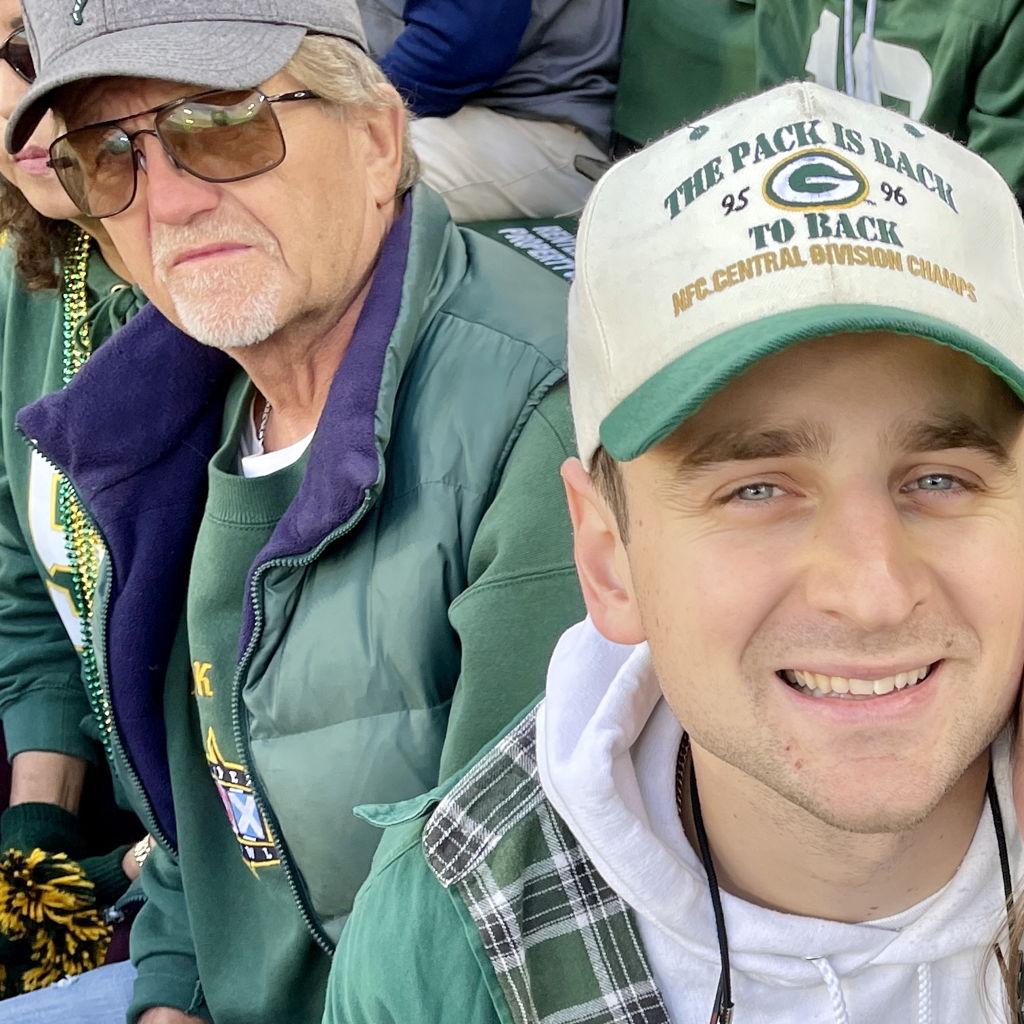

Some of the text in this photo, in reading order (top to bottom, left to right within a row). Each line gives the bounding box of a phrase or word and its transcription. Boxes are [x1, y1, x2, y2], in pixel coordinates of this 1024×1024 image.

[664, 119, 959, 220] THE PACK IS BACK
[721, 186, 750, 216] 95
[880, 181, 907, 206] 96
[748, 212, 904, 250] TO BACK
[672, 243, 977, 318] NFC CENTRAL DIVISION CHAMPS
